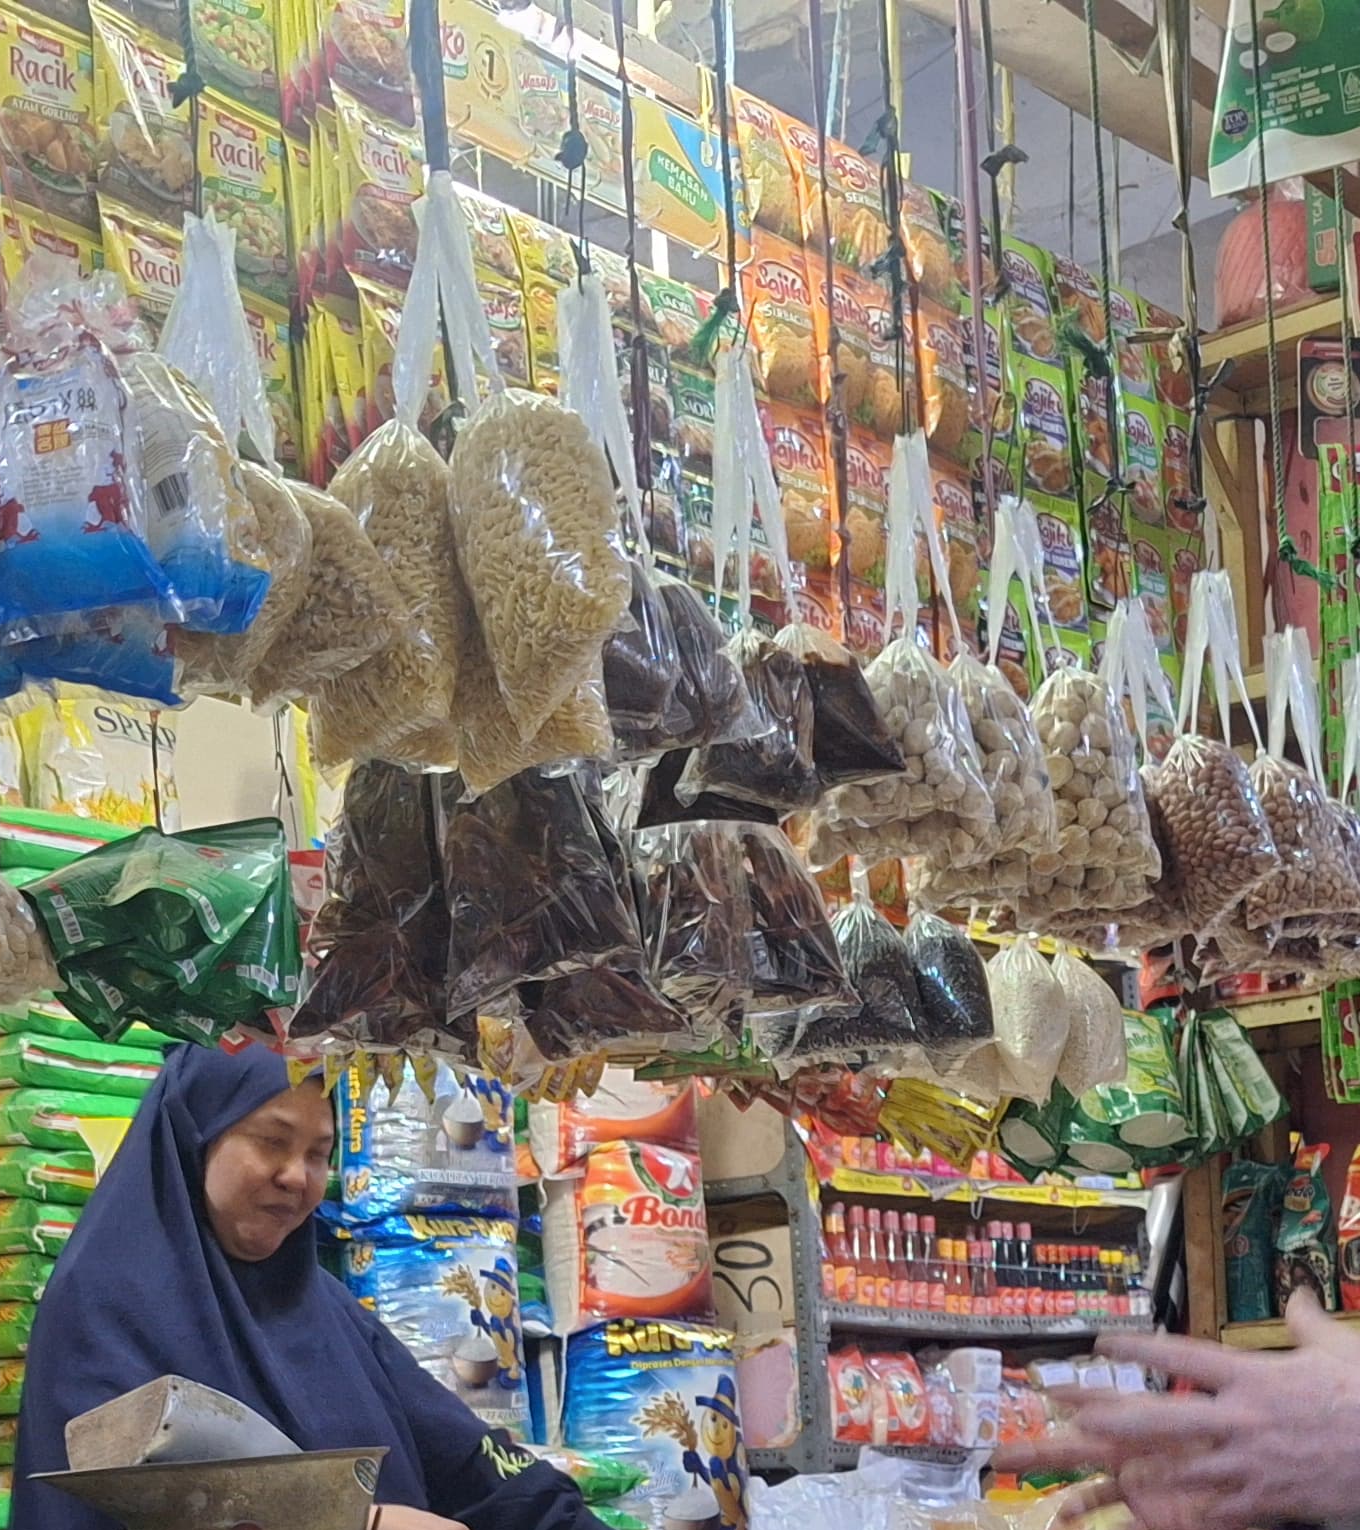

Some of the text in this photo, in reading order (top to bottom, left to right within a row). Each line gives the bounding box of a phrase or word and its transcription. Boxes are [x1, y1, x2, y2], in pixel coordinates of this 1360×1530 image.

[10, 46, 77, 92] Racik
[209, 130, 267, 175] Racik
[656, 153, 710, 204] KEMASAN
[668, 179, 698, 207] BARU
